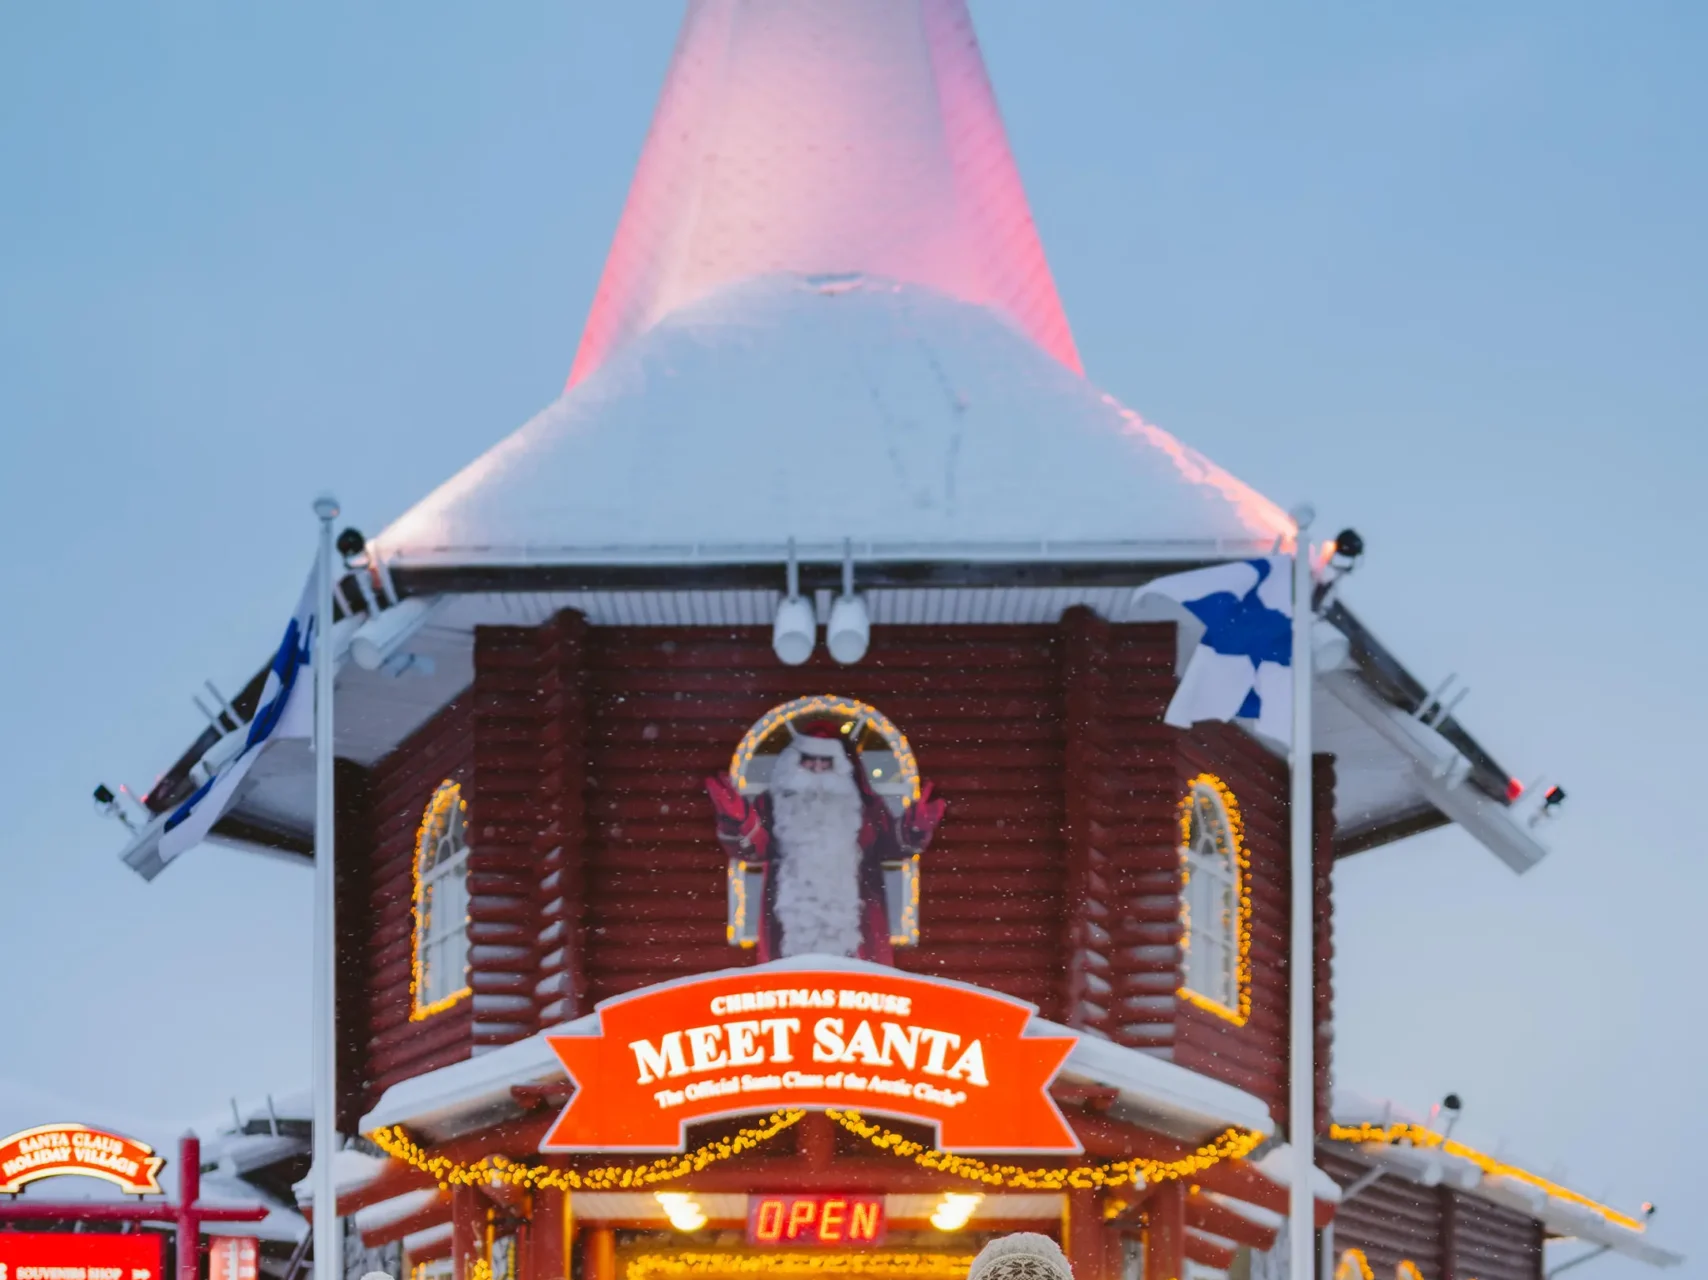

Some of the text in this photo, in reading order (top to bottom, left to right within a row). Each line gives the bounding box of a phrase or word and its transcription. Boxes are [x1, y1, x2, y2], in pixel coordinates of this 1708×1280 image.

[710, 988, 912, 1016] CHRISTMAS HOUSE
[628, 1017, 990, 1087] MEET SANTA
[654, 1088, 685, 1109] The
[684, 1076, 740, 1101] Official
[740, 1073, 782, 1090] Santa
[782, 1071, 825, 1088] Claus
[824, 1071, 845, 1088] of
[843, 1072, 868, 1090] the
[867, 1075, 914, 1097] Arctic
[18, 1132, 124, 1156] SANTA CLAUS
[1, 1147, 139, 1177] HOLIDAY VILLAGE
[757, 1199, 879, 1240] OPEN
